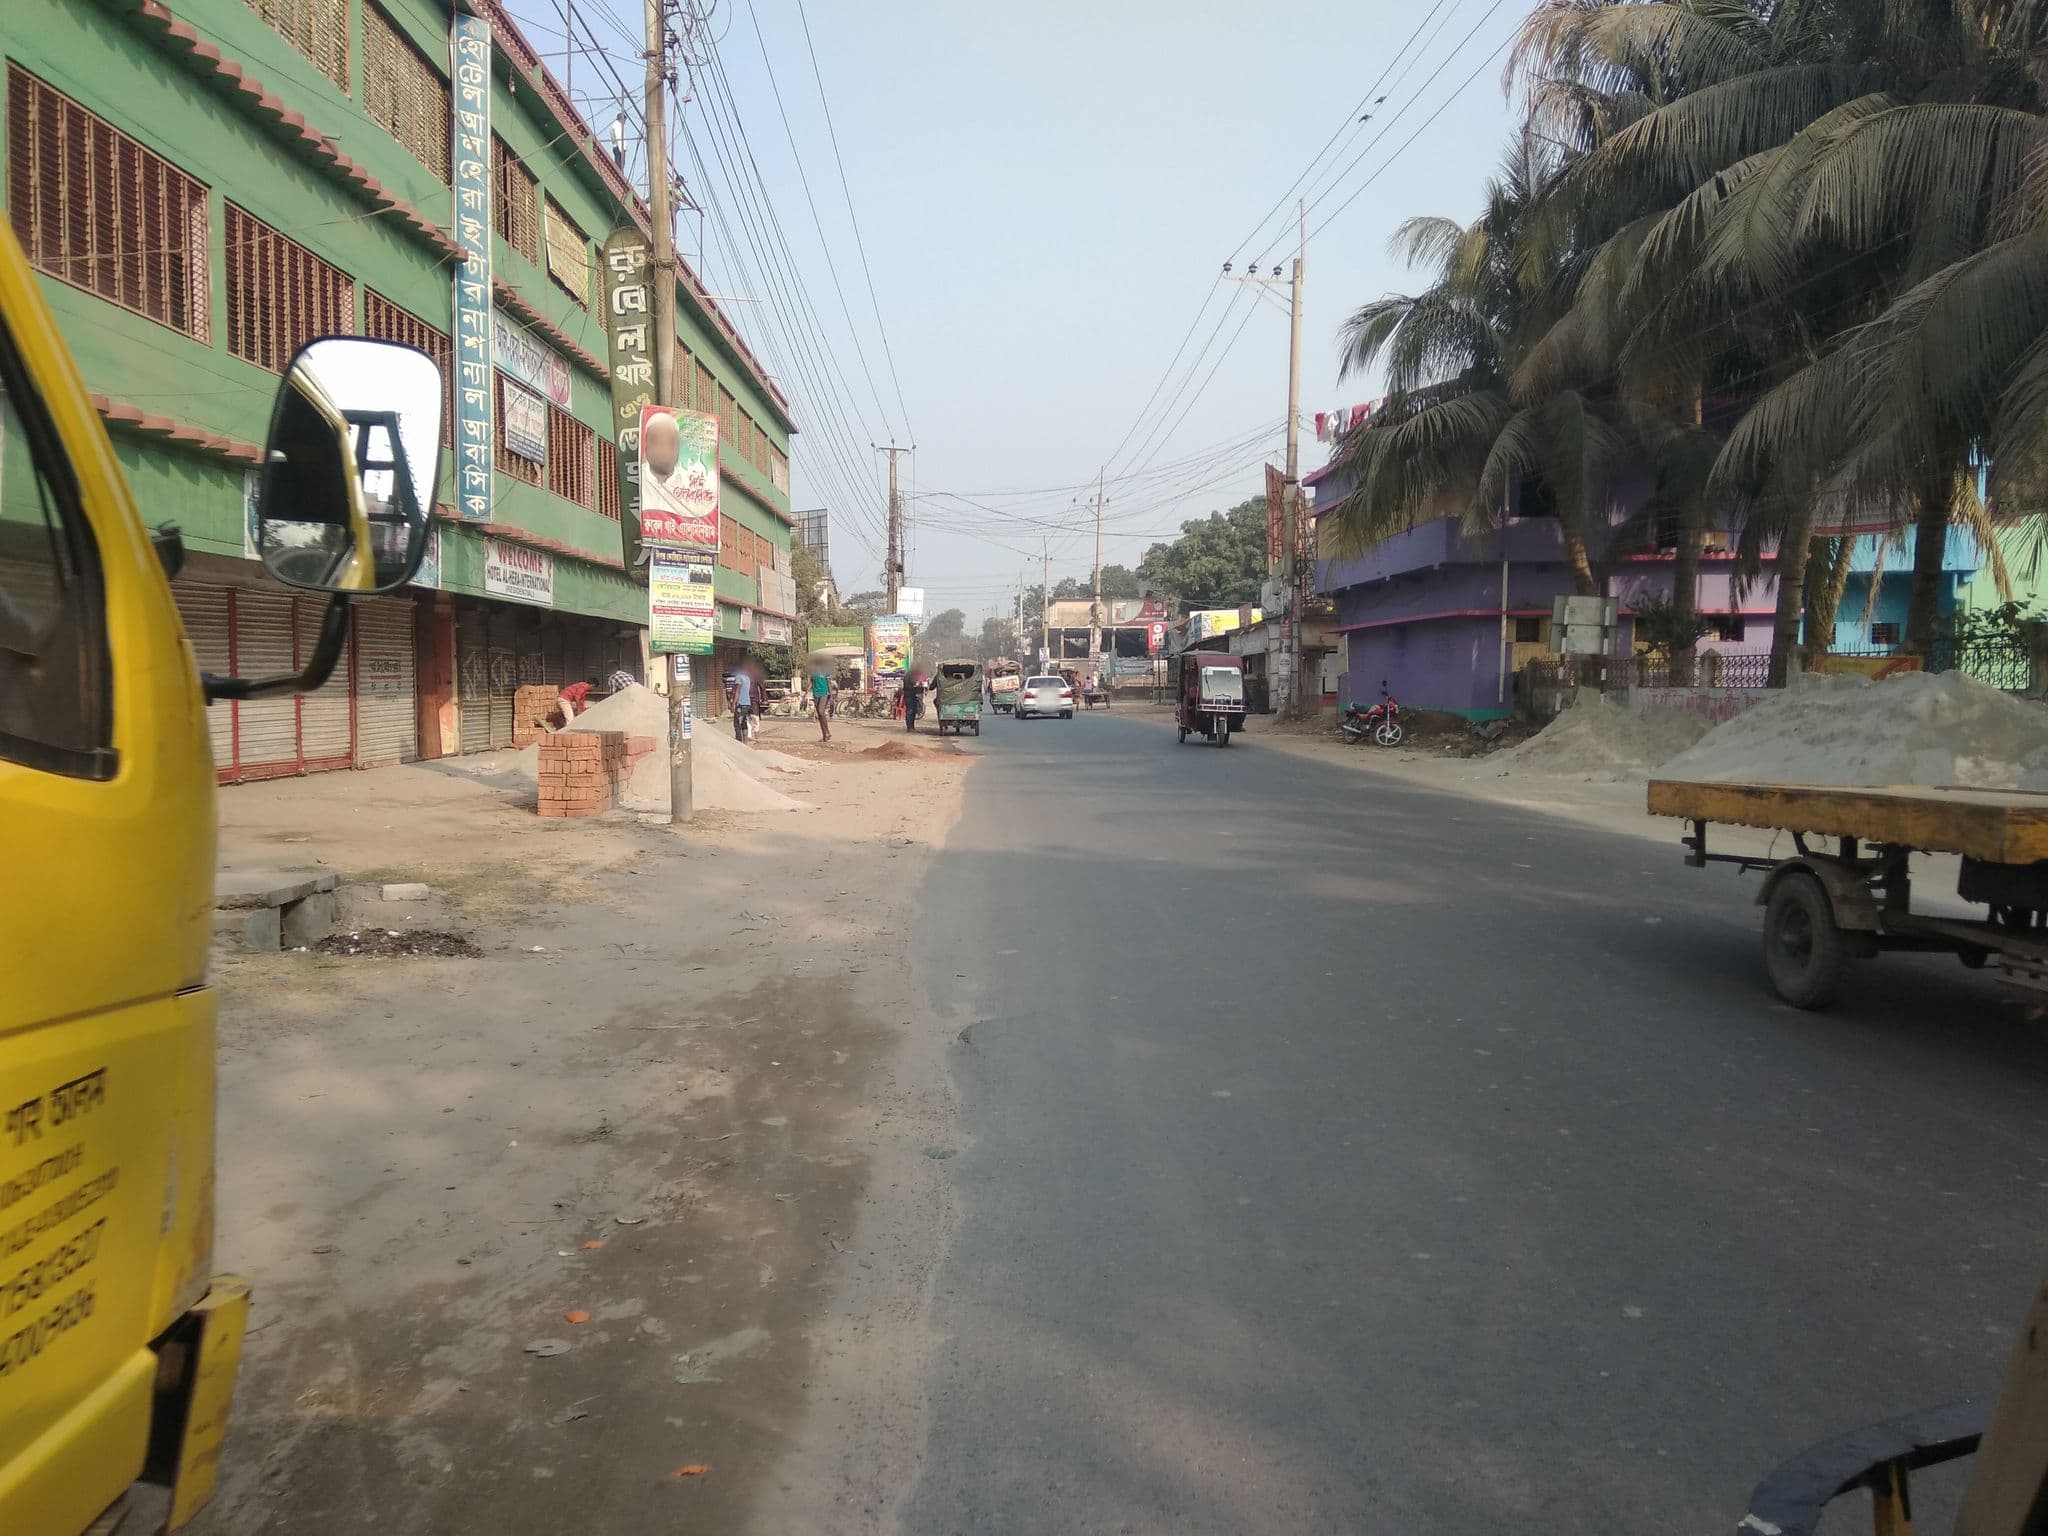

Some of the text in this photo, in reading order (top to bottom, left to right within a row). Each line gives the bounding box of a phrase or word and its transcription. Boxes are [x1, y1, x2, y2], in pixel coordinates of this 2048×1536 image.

[459, 36, 486, 110] হোটেল
[459, 110, 486, 155] আল
[459, 160, 486, 211] হেরা
[609, 245, 648, 352] রুবেল
[616, 355, 655, 387] থাই
[463, 418, 488, 515] আবাসিক
[643, 518, 664, 534] রুবেল
[664, 518, 678, 537] থাই
[487, 565, 502, 582] HOTEL
[497, 541, 544, 574] WELCOME
